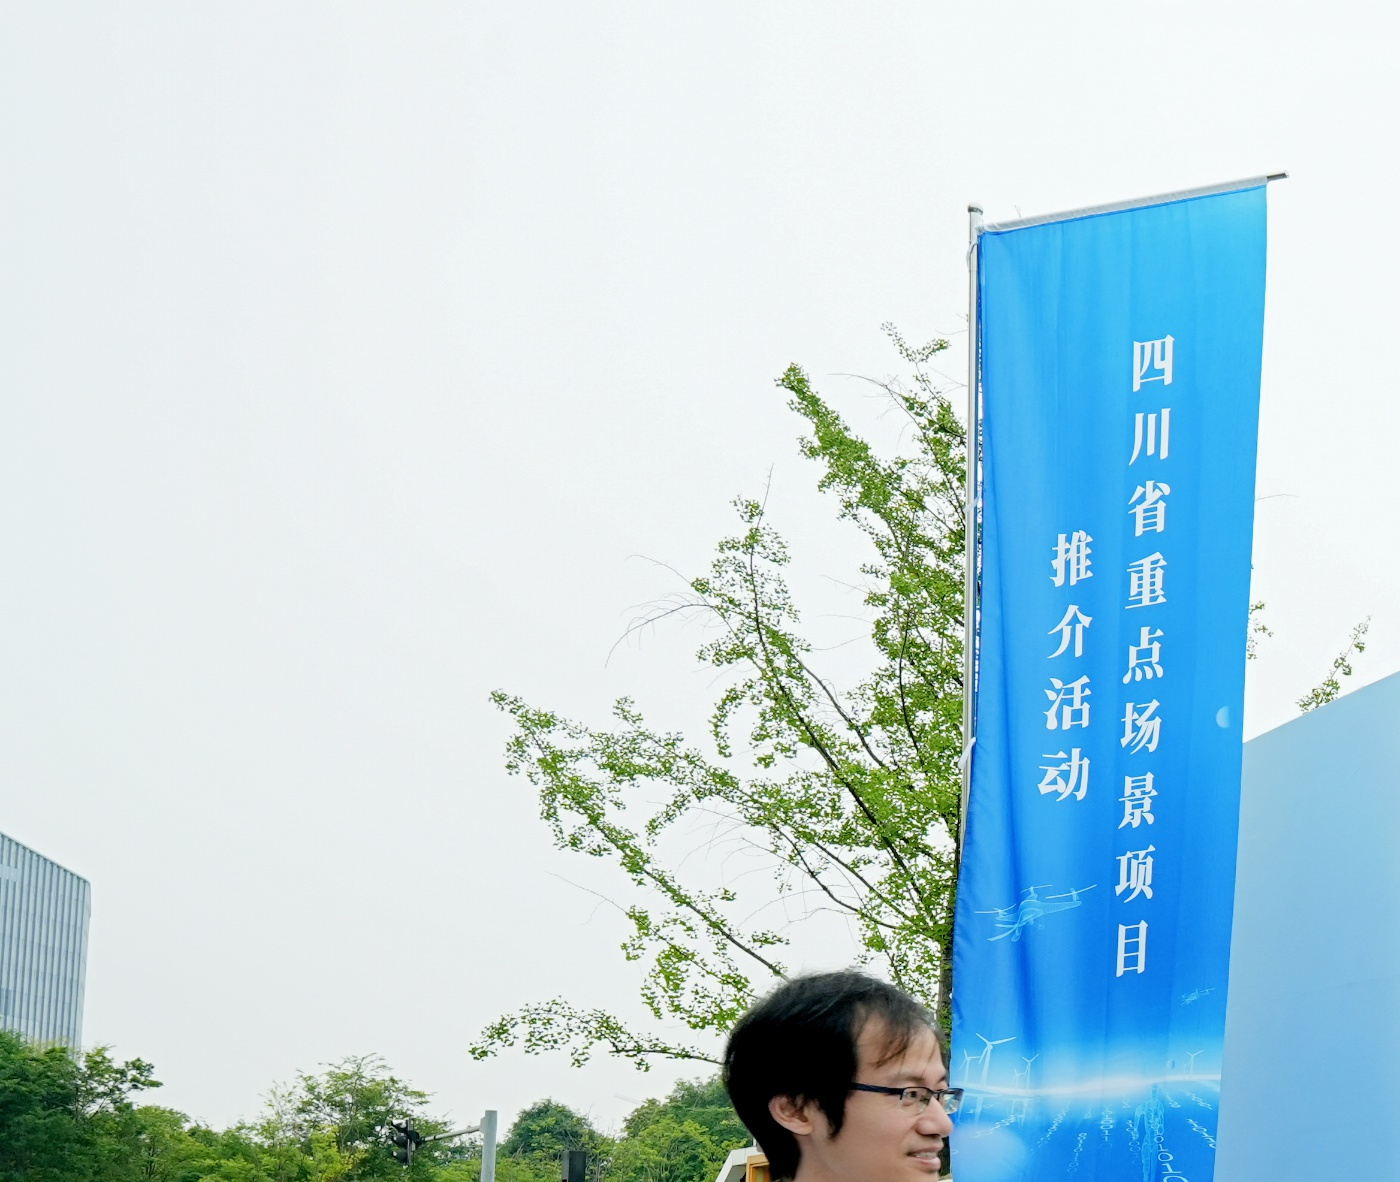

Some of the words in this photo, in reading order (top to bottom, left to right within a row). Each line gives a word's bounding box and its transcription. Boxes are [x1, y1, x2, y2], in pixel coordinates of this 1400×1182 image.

[1037, 529, 1093, 803] 推介活动
[1114, 333, 1175, 978] 四川省重点场景项目
